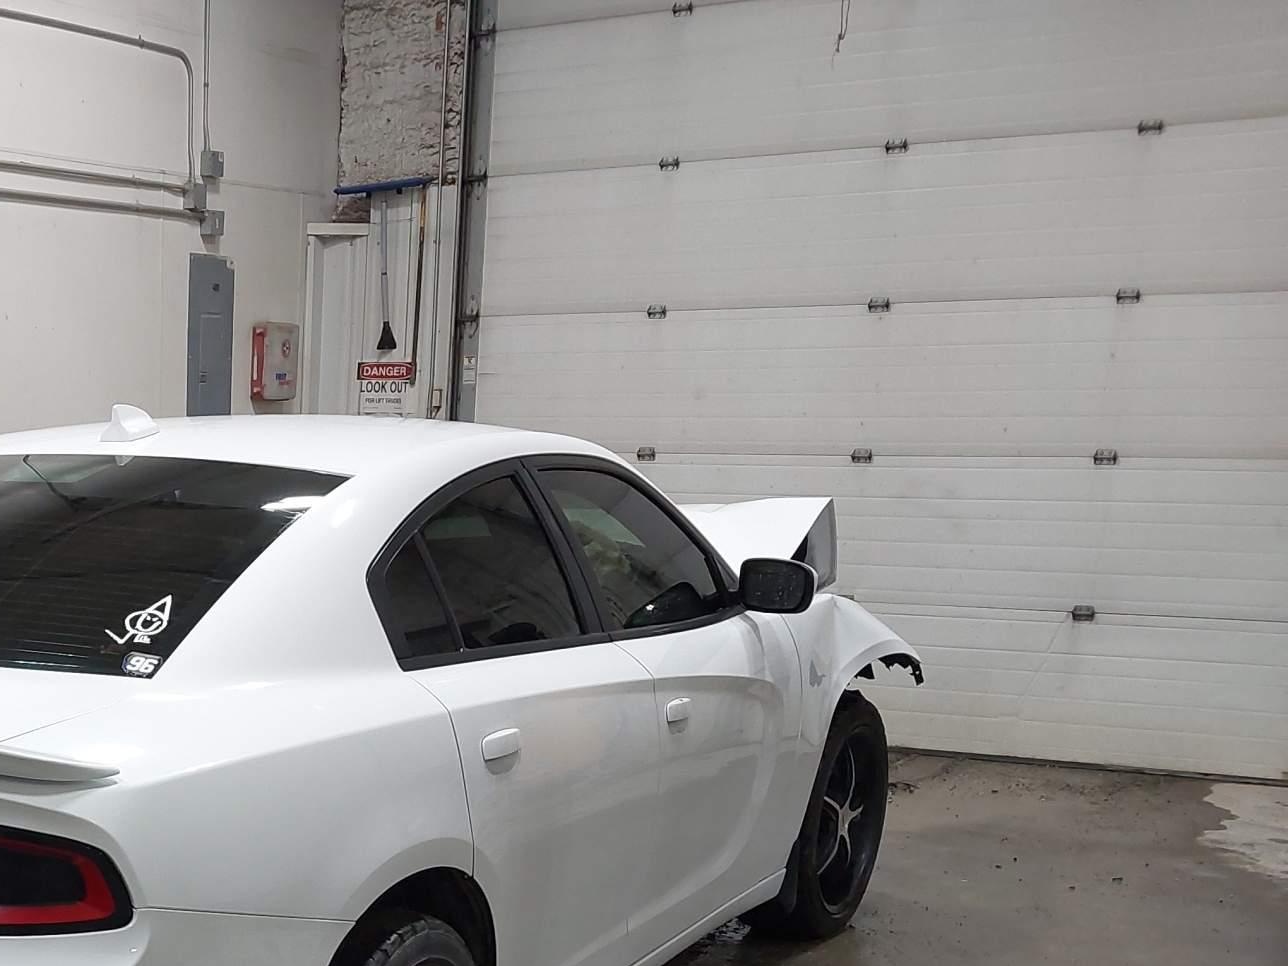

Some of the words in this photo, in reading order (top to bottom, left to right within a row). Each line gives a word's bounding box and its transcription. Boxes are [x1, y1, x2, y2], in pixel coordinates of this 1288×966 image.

[363, 366, 407, 376] DANGER
[360, 381, 387, 393] LOOK
[390, 381, 408, 393] OUT
[126, 656, 158, 673] 96
